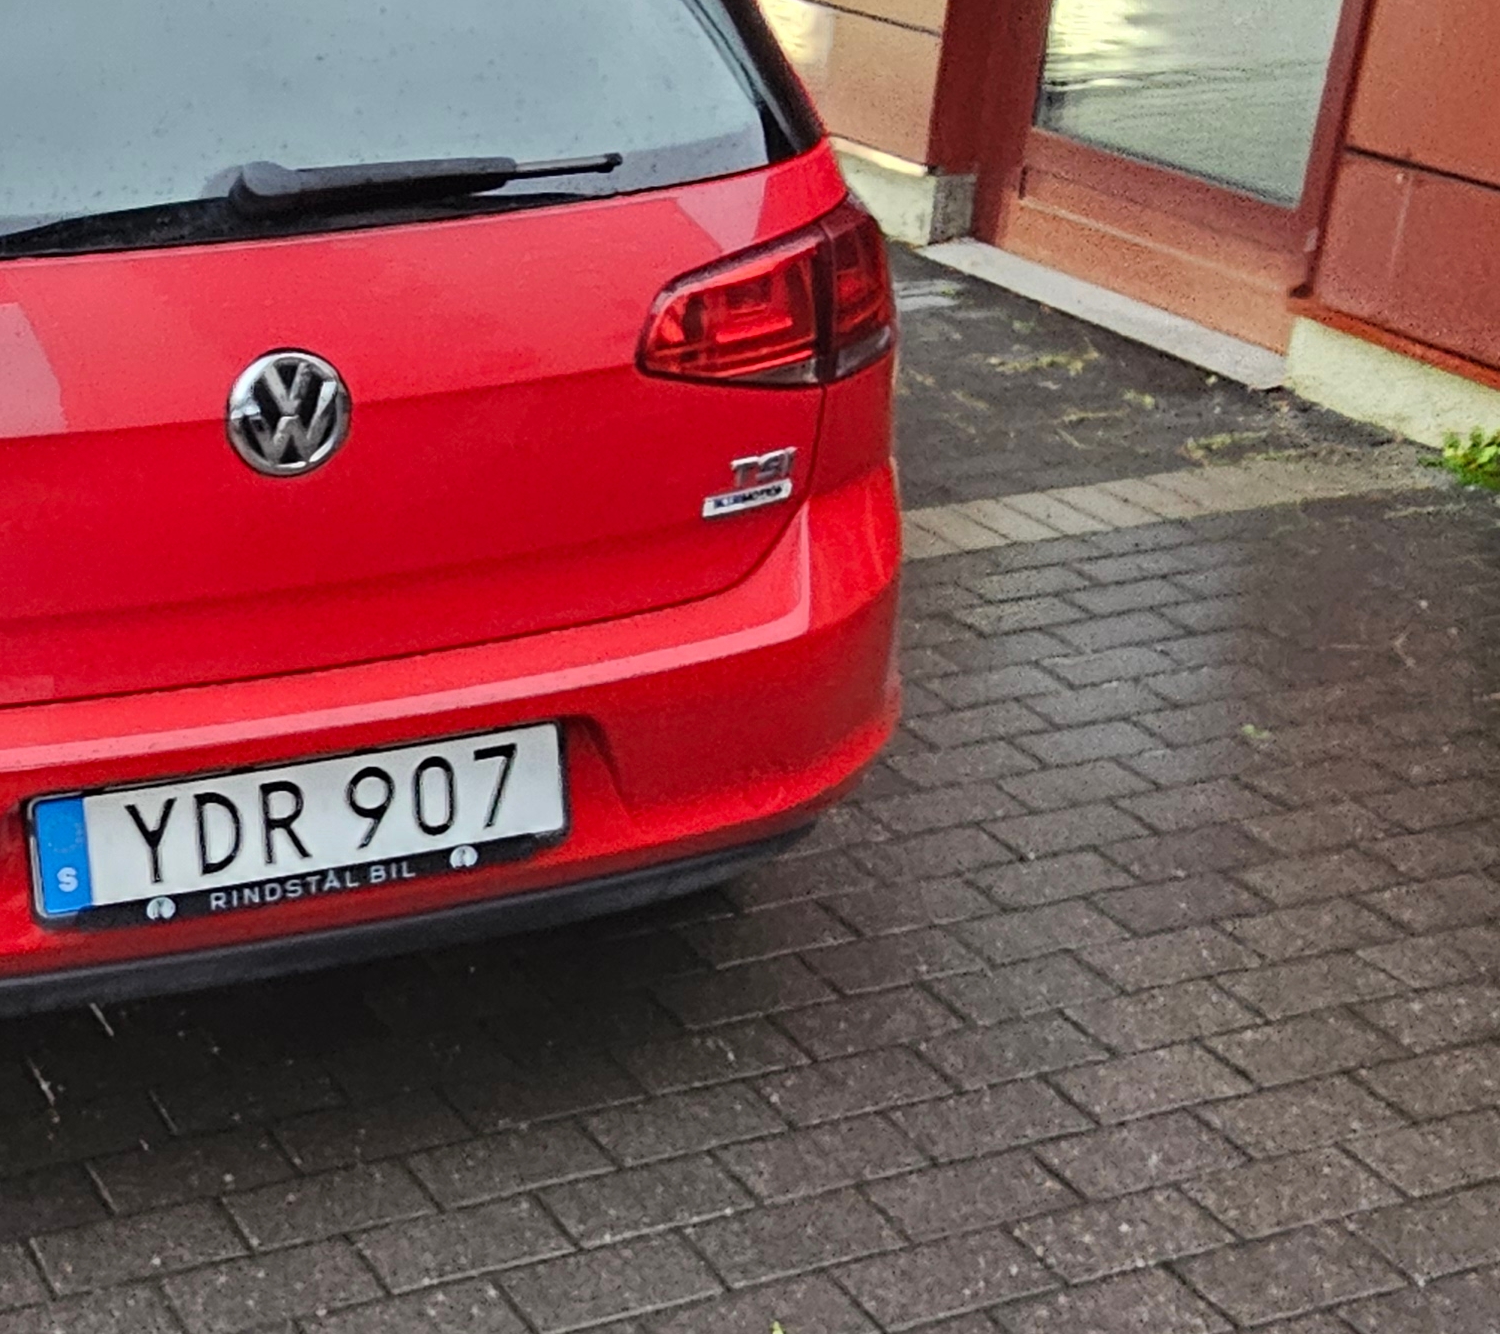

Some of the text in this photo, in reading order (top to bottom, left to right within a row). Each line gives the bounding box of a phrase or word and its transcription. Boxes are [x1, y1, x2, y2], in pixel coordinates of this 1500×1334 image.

[124, 743, 518, 884] YDR 907
[56, 866, 79, 893] S
[369, 861, 416, 884] BIL
